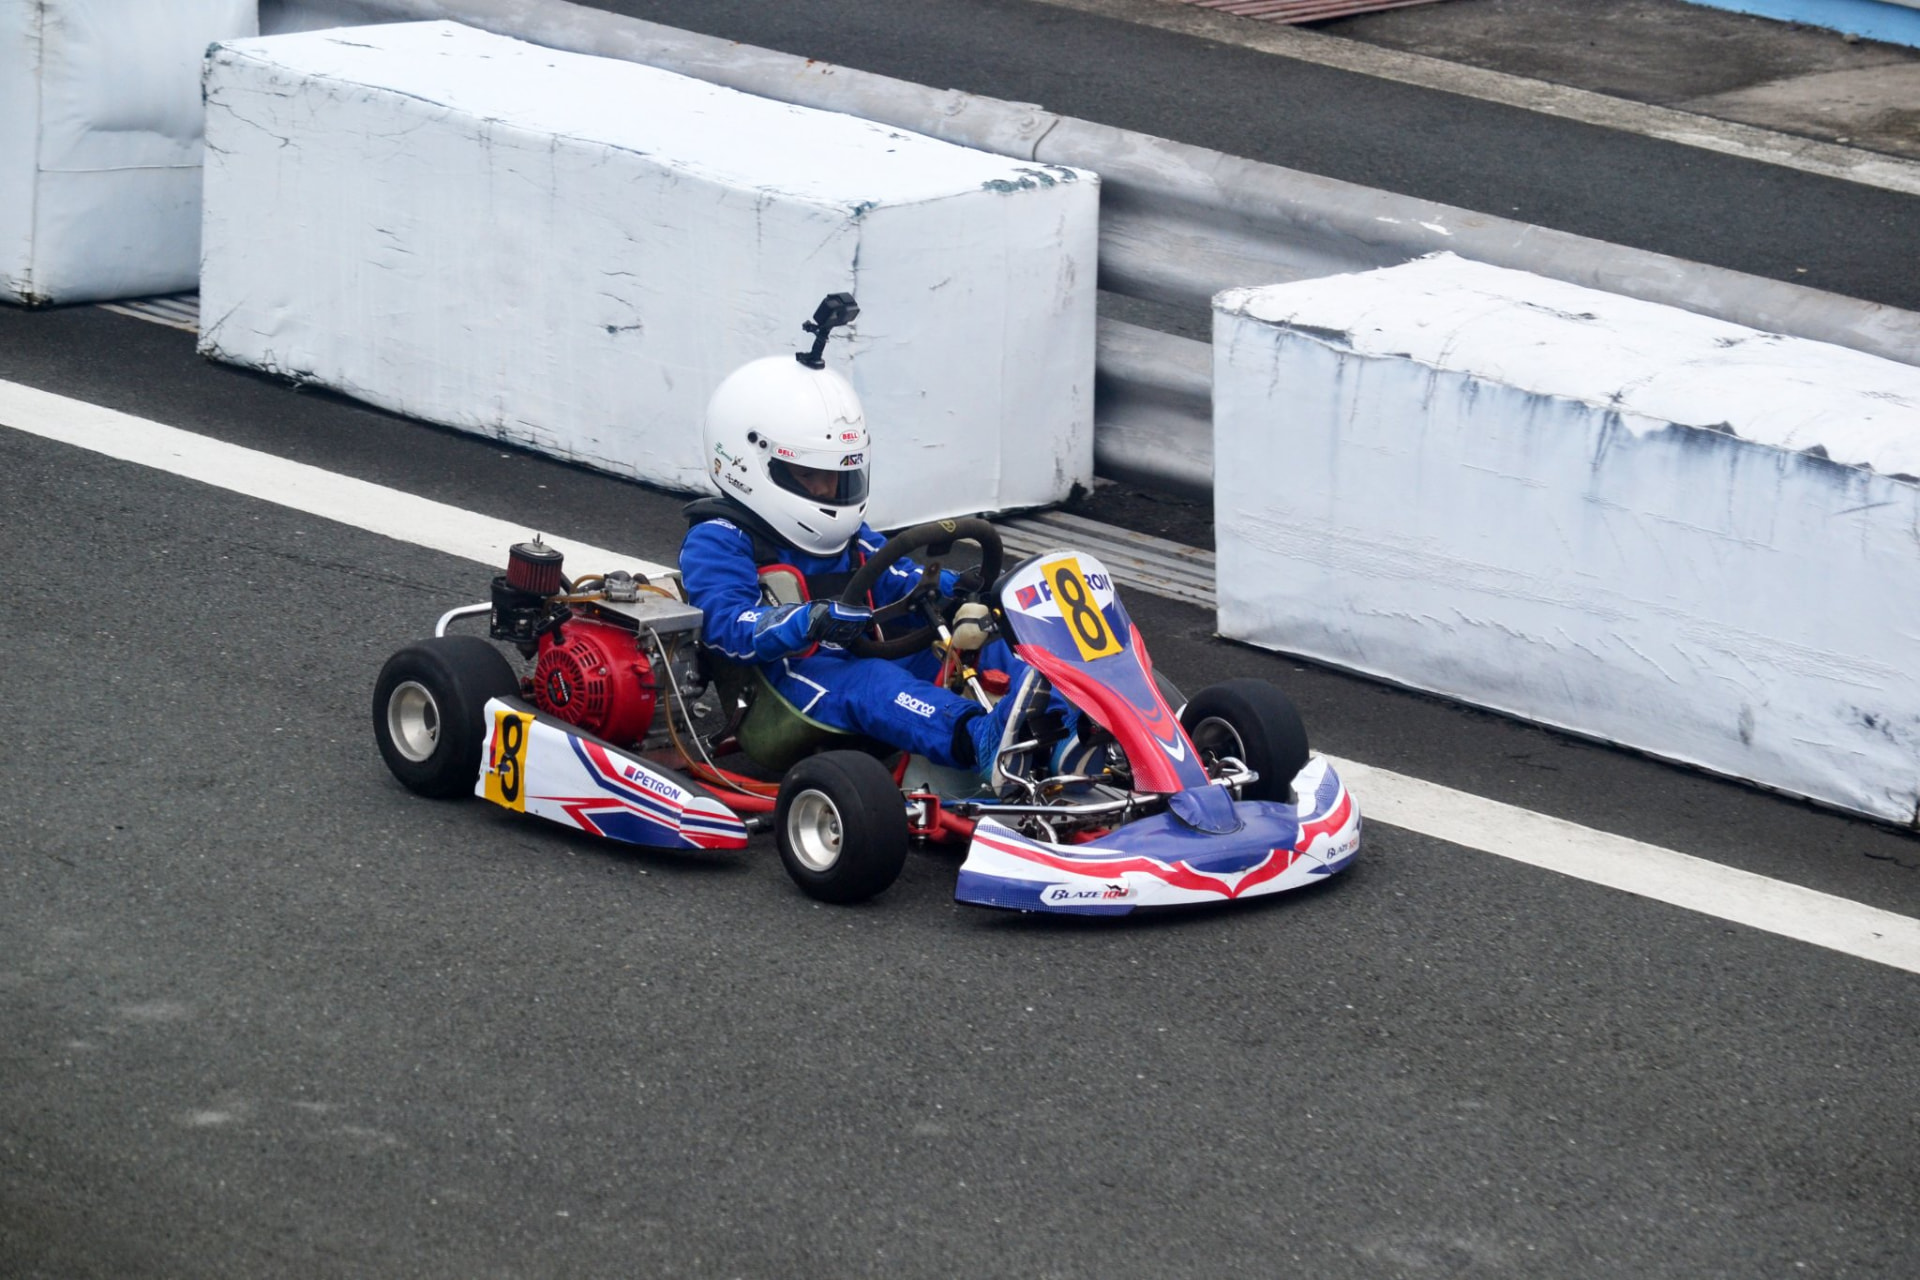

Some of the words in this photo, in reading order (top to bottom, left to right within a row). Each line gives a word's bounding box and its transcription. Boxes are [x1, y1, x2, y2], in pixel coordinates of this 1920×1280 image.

[778, 448, 795, 457] BELL
[1055, 567, 1107, 651] 8
[895, 691, 936, 717] sparco
[500, 714, 522, 802] 8
[634, 771, 681, 799] PETRON
